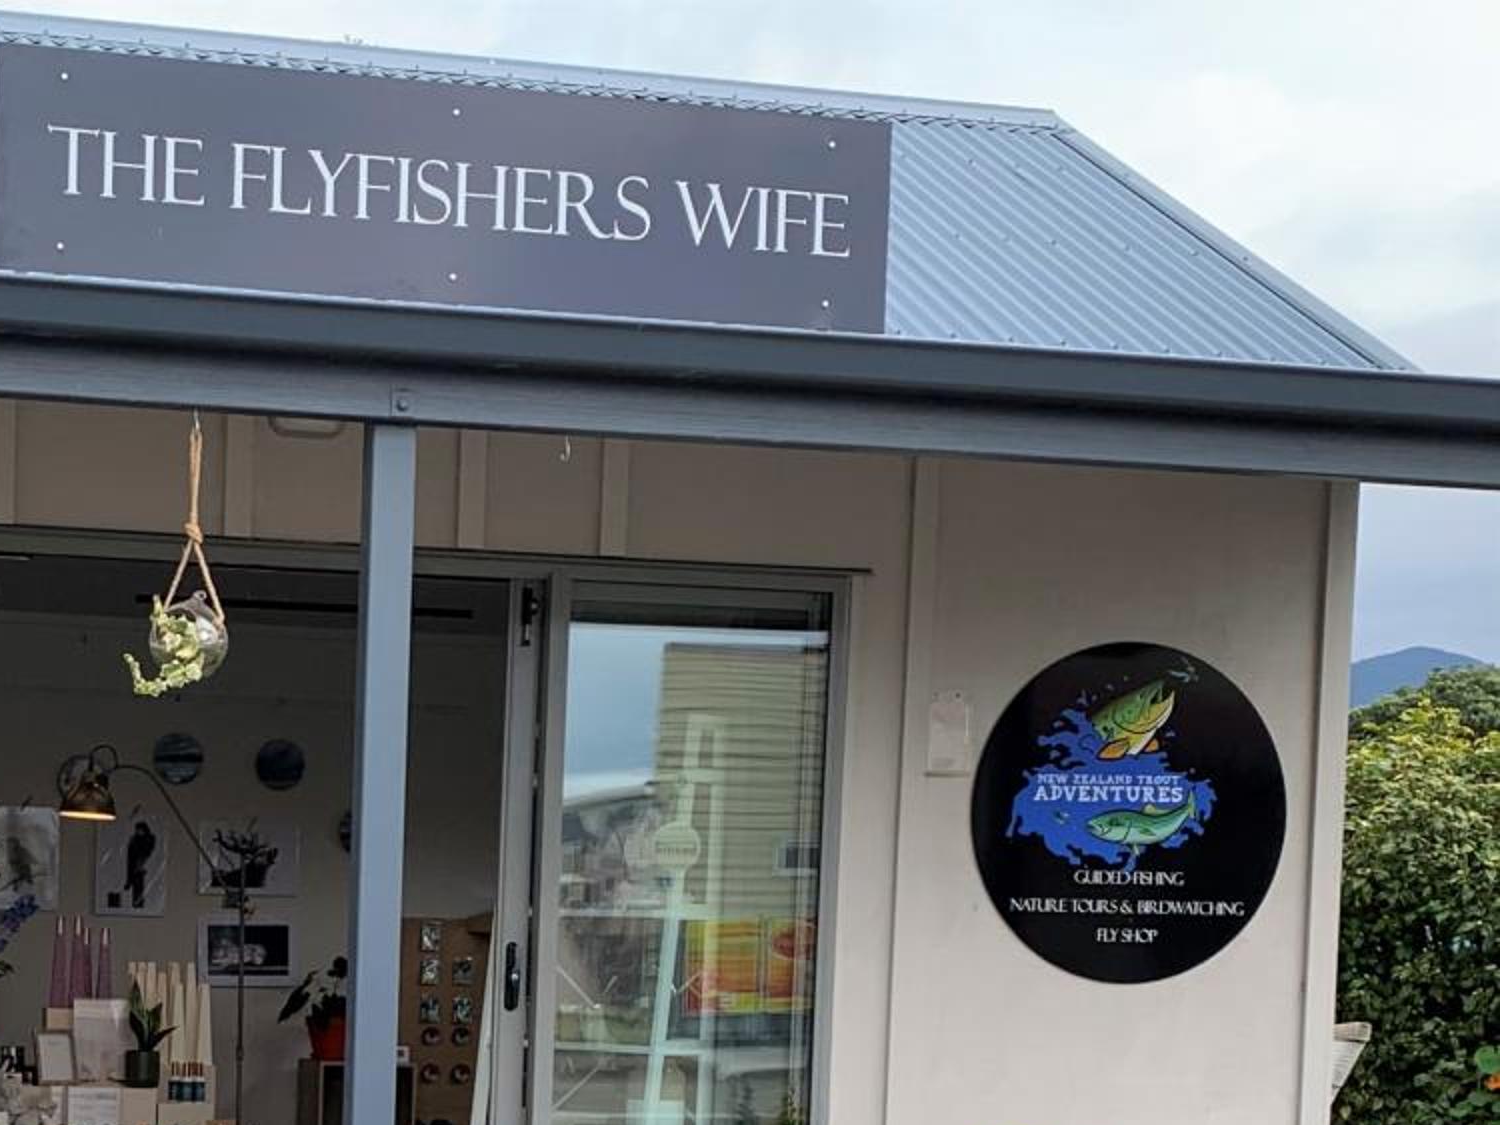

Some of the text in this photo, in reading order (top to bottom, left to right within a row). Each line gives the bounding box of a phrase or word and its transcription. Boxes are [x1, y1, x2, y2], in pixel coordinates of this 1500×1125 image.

[47, 123, 852, 259] THE FLYFISHERS WIFE
[1037, 773, 1181, 786] NEW ZEALAND TROUT
[1033, 785, 1184, 803] ADVENTURES
[1073, 869, 1186, 887] GUIDED FISHING
[1009, 897, 1246, 917] NATURE TOURS & BIRDWATCHING
[1096, 927, 1159, 943] FLY SHOP
